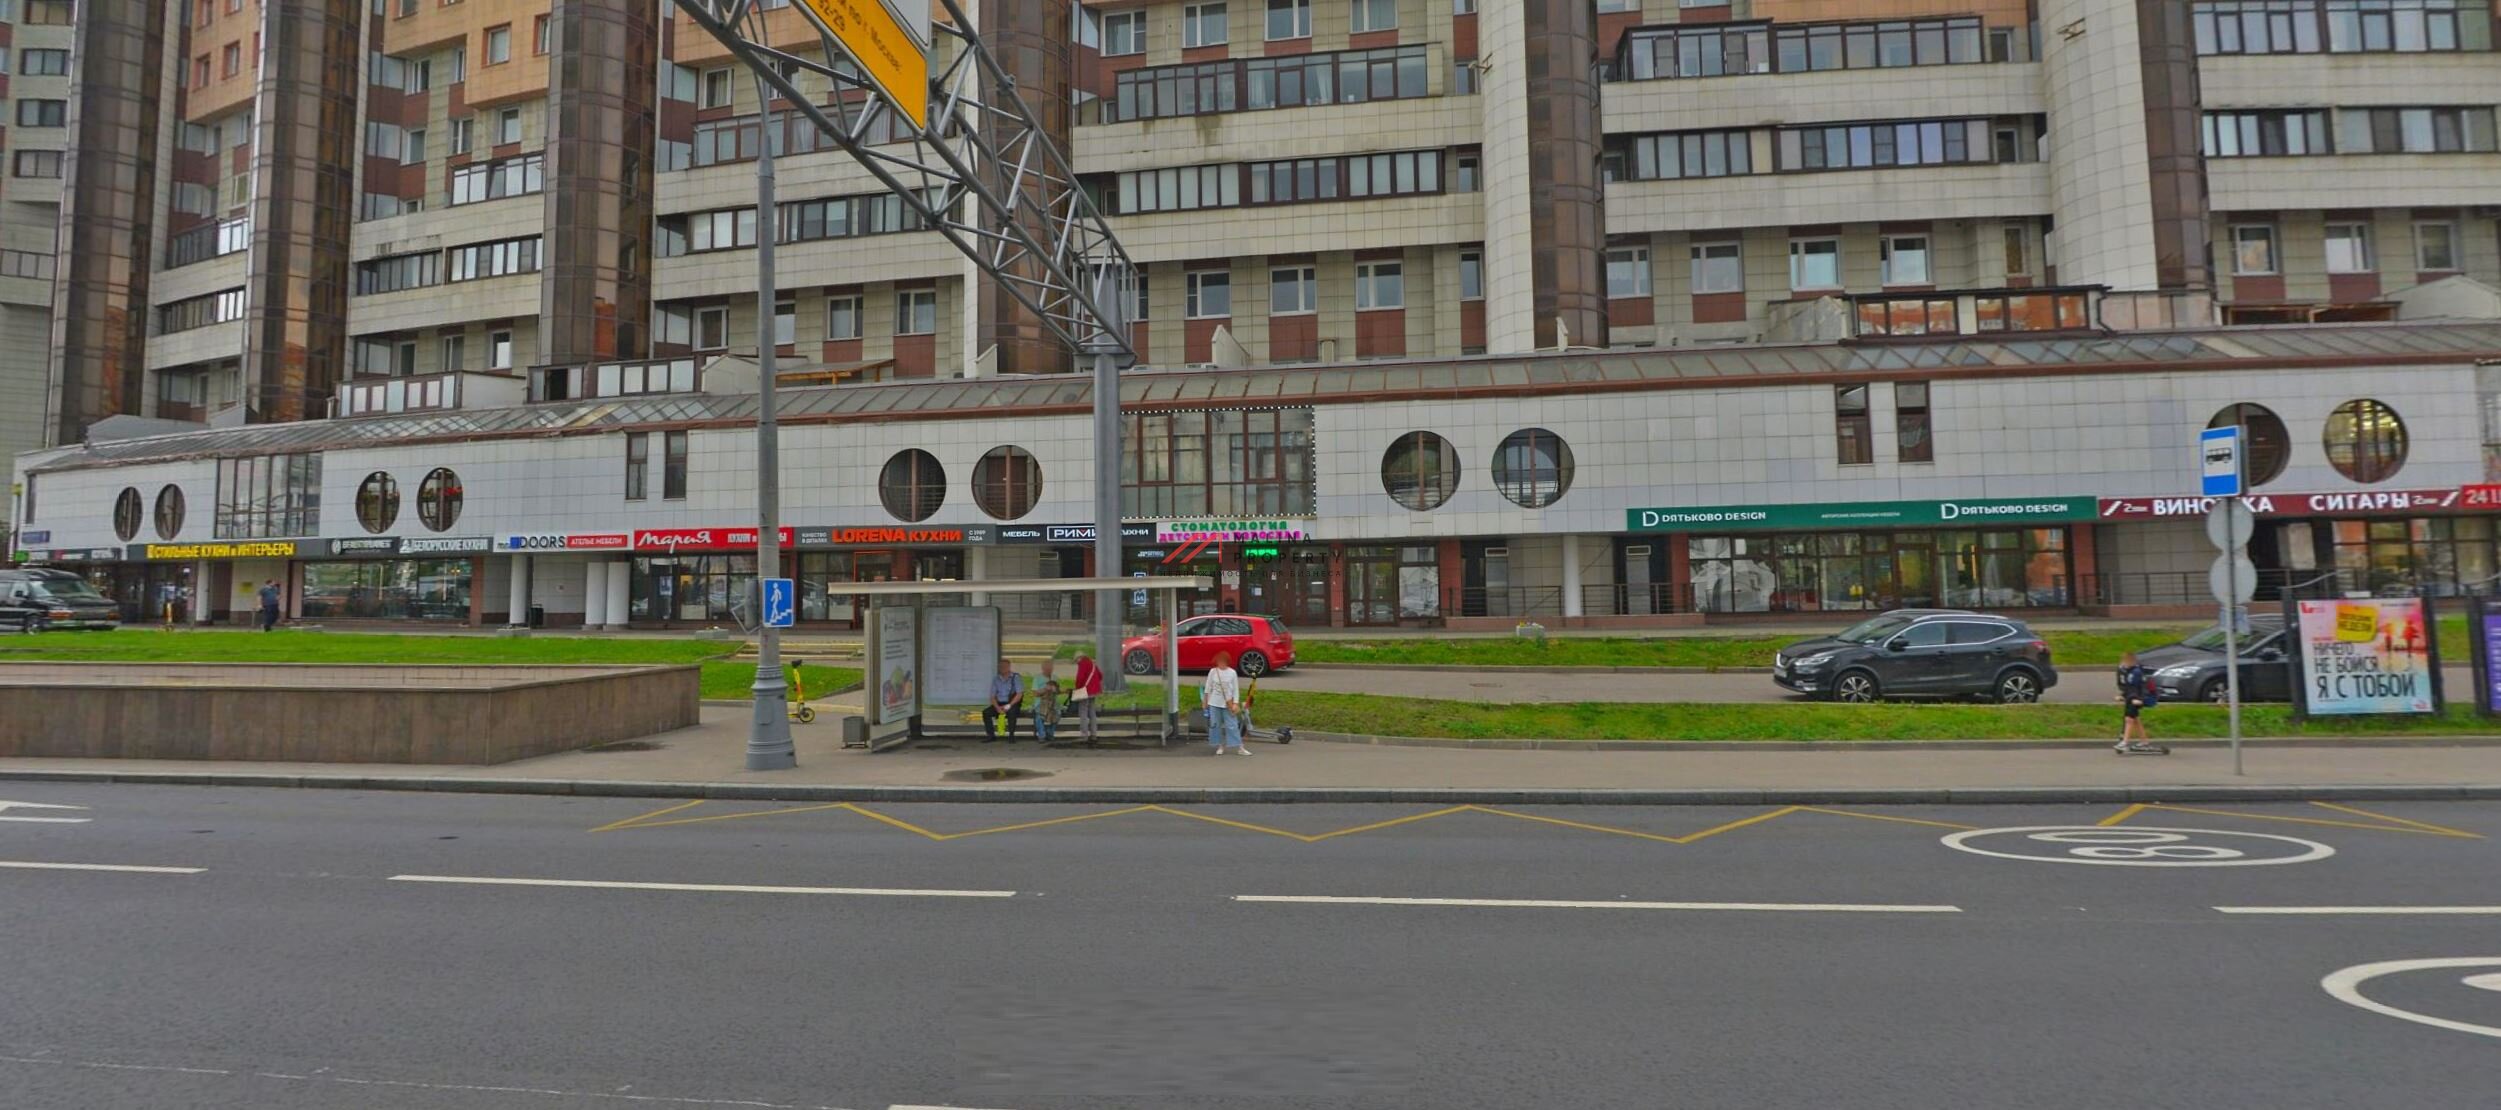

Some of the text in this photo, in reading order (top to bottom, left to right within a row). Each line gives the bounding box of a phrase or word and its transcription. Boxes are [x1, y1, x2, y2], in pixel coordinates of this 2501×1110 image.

[2026, 504, 2068, 513] DESIGN
[2309, 494, 2410, 511] СИГАРЫ
[1725, 511, 1766, 521] DESIGN
[1171, 521, 1288, 532] СТОМАТОЛОГИЯ
[519, 536, 565, 548] DOORS
[638, 531, 712, 554] Мария
[831, 528, 963, 543] LORENA КУХНИ
[2315, 657, 2331, 673] НЕ
[2317, 676, 2329, 698] Я
[2336, 675, 2348, 698] С
